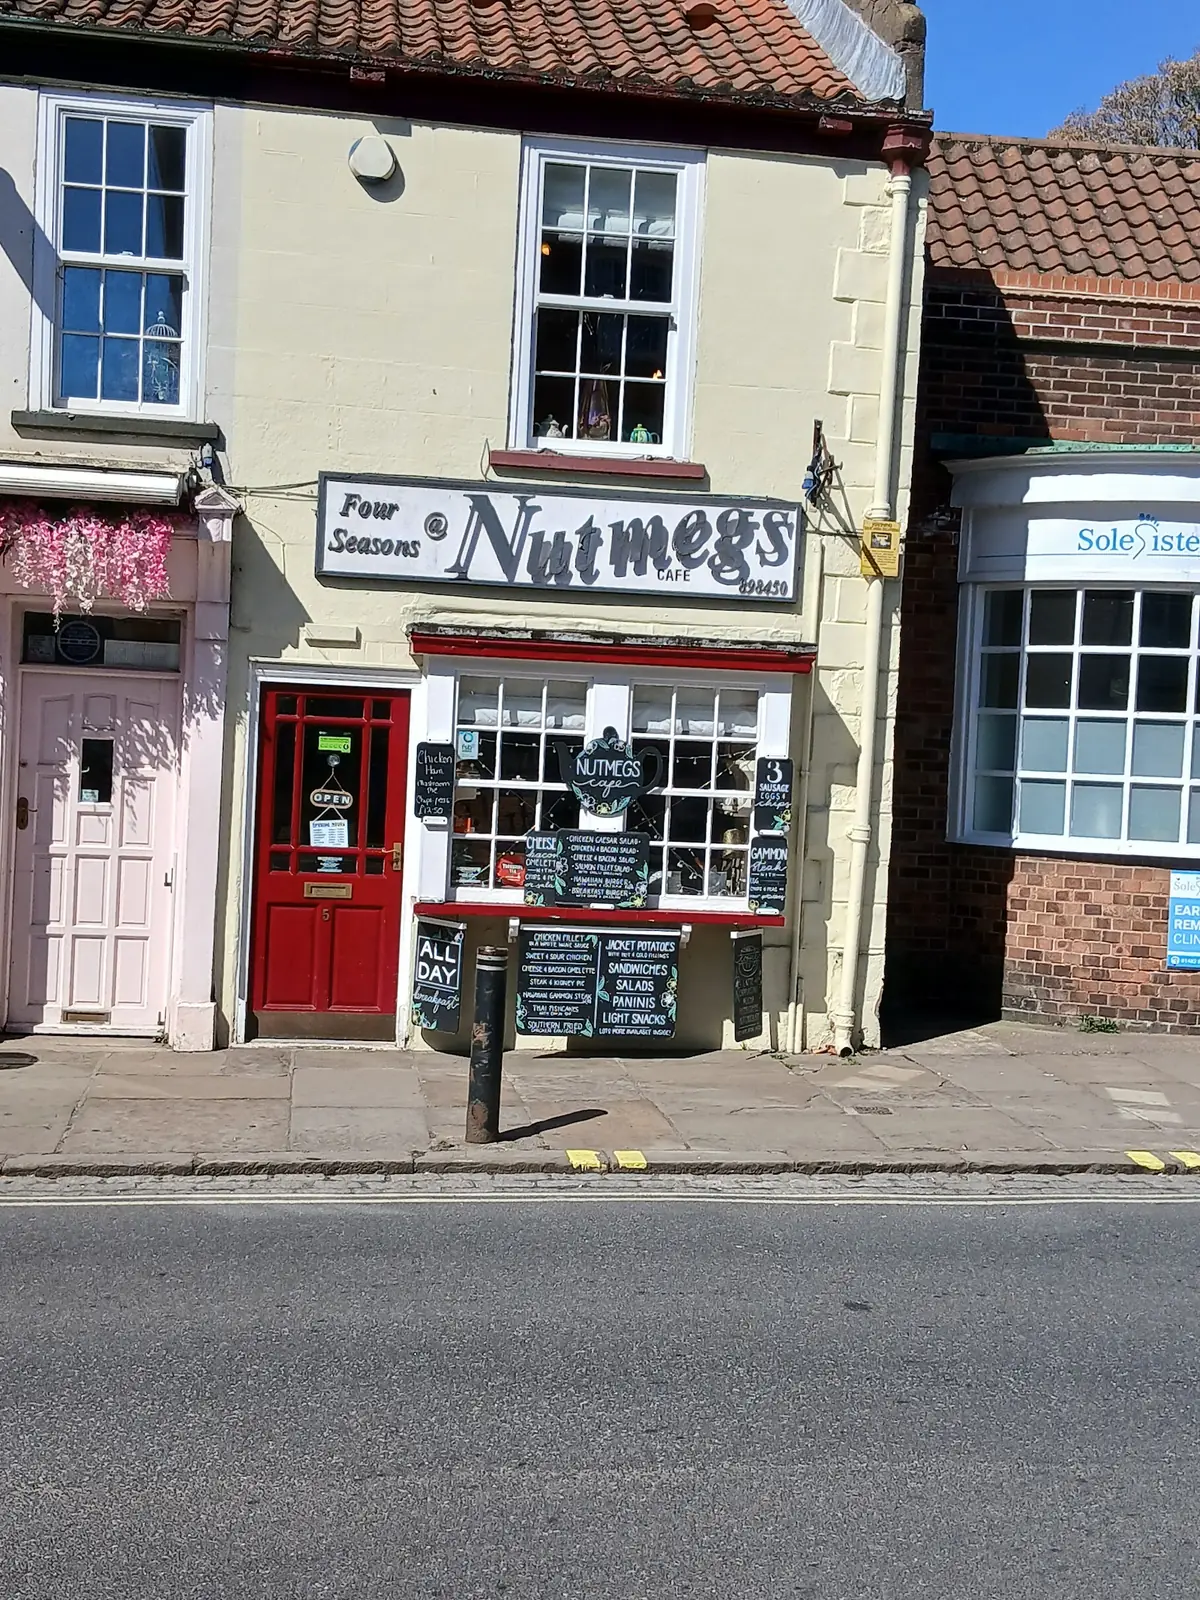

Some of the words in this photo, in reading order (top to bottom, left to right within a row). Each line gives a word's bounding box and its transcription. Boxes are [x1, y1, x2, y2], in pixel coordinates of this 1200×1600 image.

[339, 493, 399, 520] Four
[328, 528, 420, 558] Seasons
[424, 512, 448, 541] @
[444, 494, 795, 585] Nutmegs
[657, 569, 690, 582] CAFE
[418, 750, 452, 764] Chicken
[425, 765, 444, 775] Ham
[576, 759, 640, 777] NUTMEGS
[767, 761, 783, 784] 3
[760, 783, 789, 792] SAUSAGE
[314, 794, 350, 804] OPEN
[755, 799, 792, 809] chips
[527, 836, 557, 850] CHEESE
[569, 835, 594, 843] CHICKEN
[595, 836, 618, 844] CAESAR
[619, 837, 639, 845] SALAD
[620, 847, 637, 855] SALAD
[752, 848, 788, 861] GAMMON
[526, 859, 557, 867] OMELETT
[572, 887, 605, 895] BREAKFAST
[606, 889, 629, 897] BURGER
[323, 909, 330, 921] 5
[1175, 905, 1200, 917] EAR
[1174, 919, 1200, 931] REM
[534, 933, 561, 942] CHICKEN
[563, 935, 585, 943] FILLET
[420, 941, 456, 964] ALL
[605, 940, 636, 951] JACKET
[637, 941, 676, 953] POTATOES
[526, 952, 545, 960] SWEET
[418, 962, 457, 985] DAY
[548, 966, 567, 974] BACON
[567, 967, 596, 975] OMELETTE
[608, 963, 668, 976] SANDWICHES
[616, 980, 655, 992] SALADS
[413, 986, 460, 1013] breakfast
[613, 996, 656, 1009] PANINIS
[603, 1012, 629, 1024] LIGHT
[631, 1013, 667, 1025] SNACKS
[528, 1021, 561, 1029] SOUTHERN
[564, 1022, 583, 1030] FRIED
